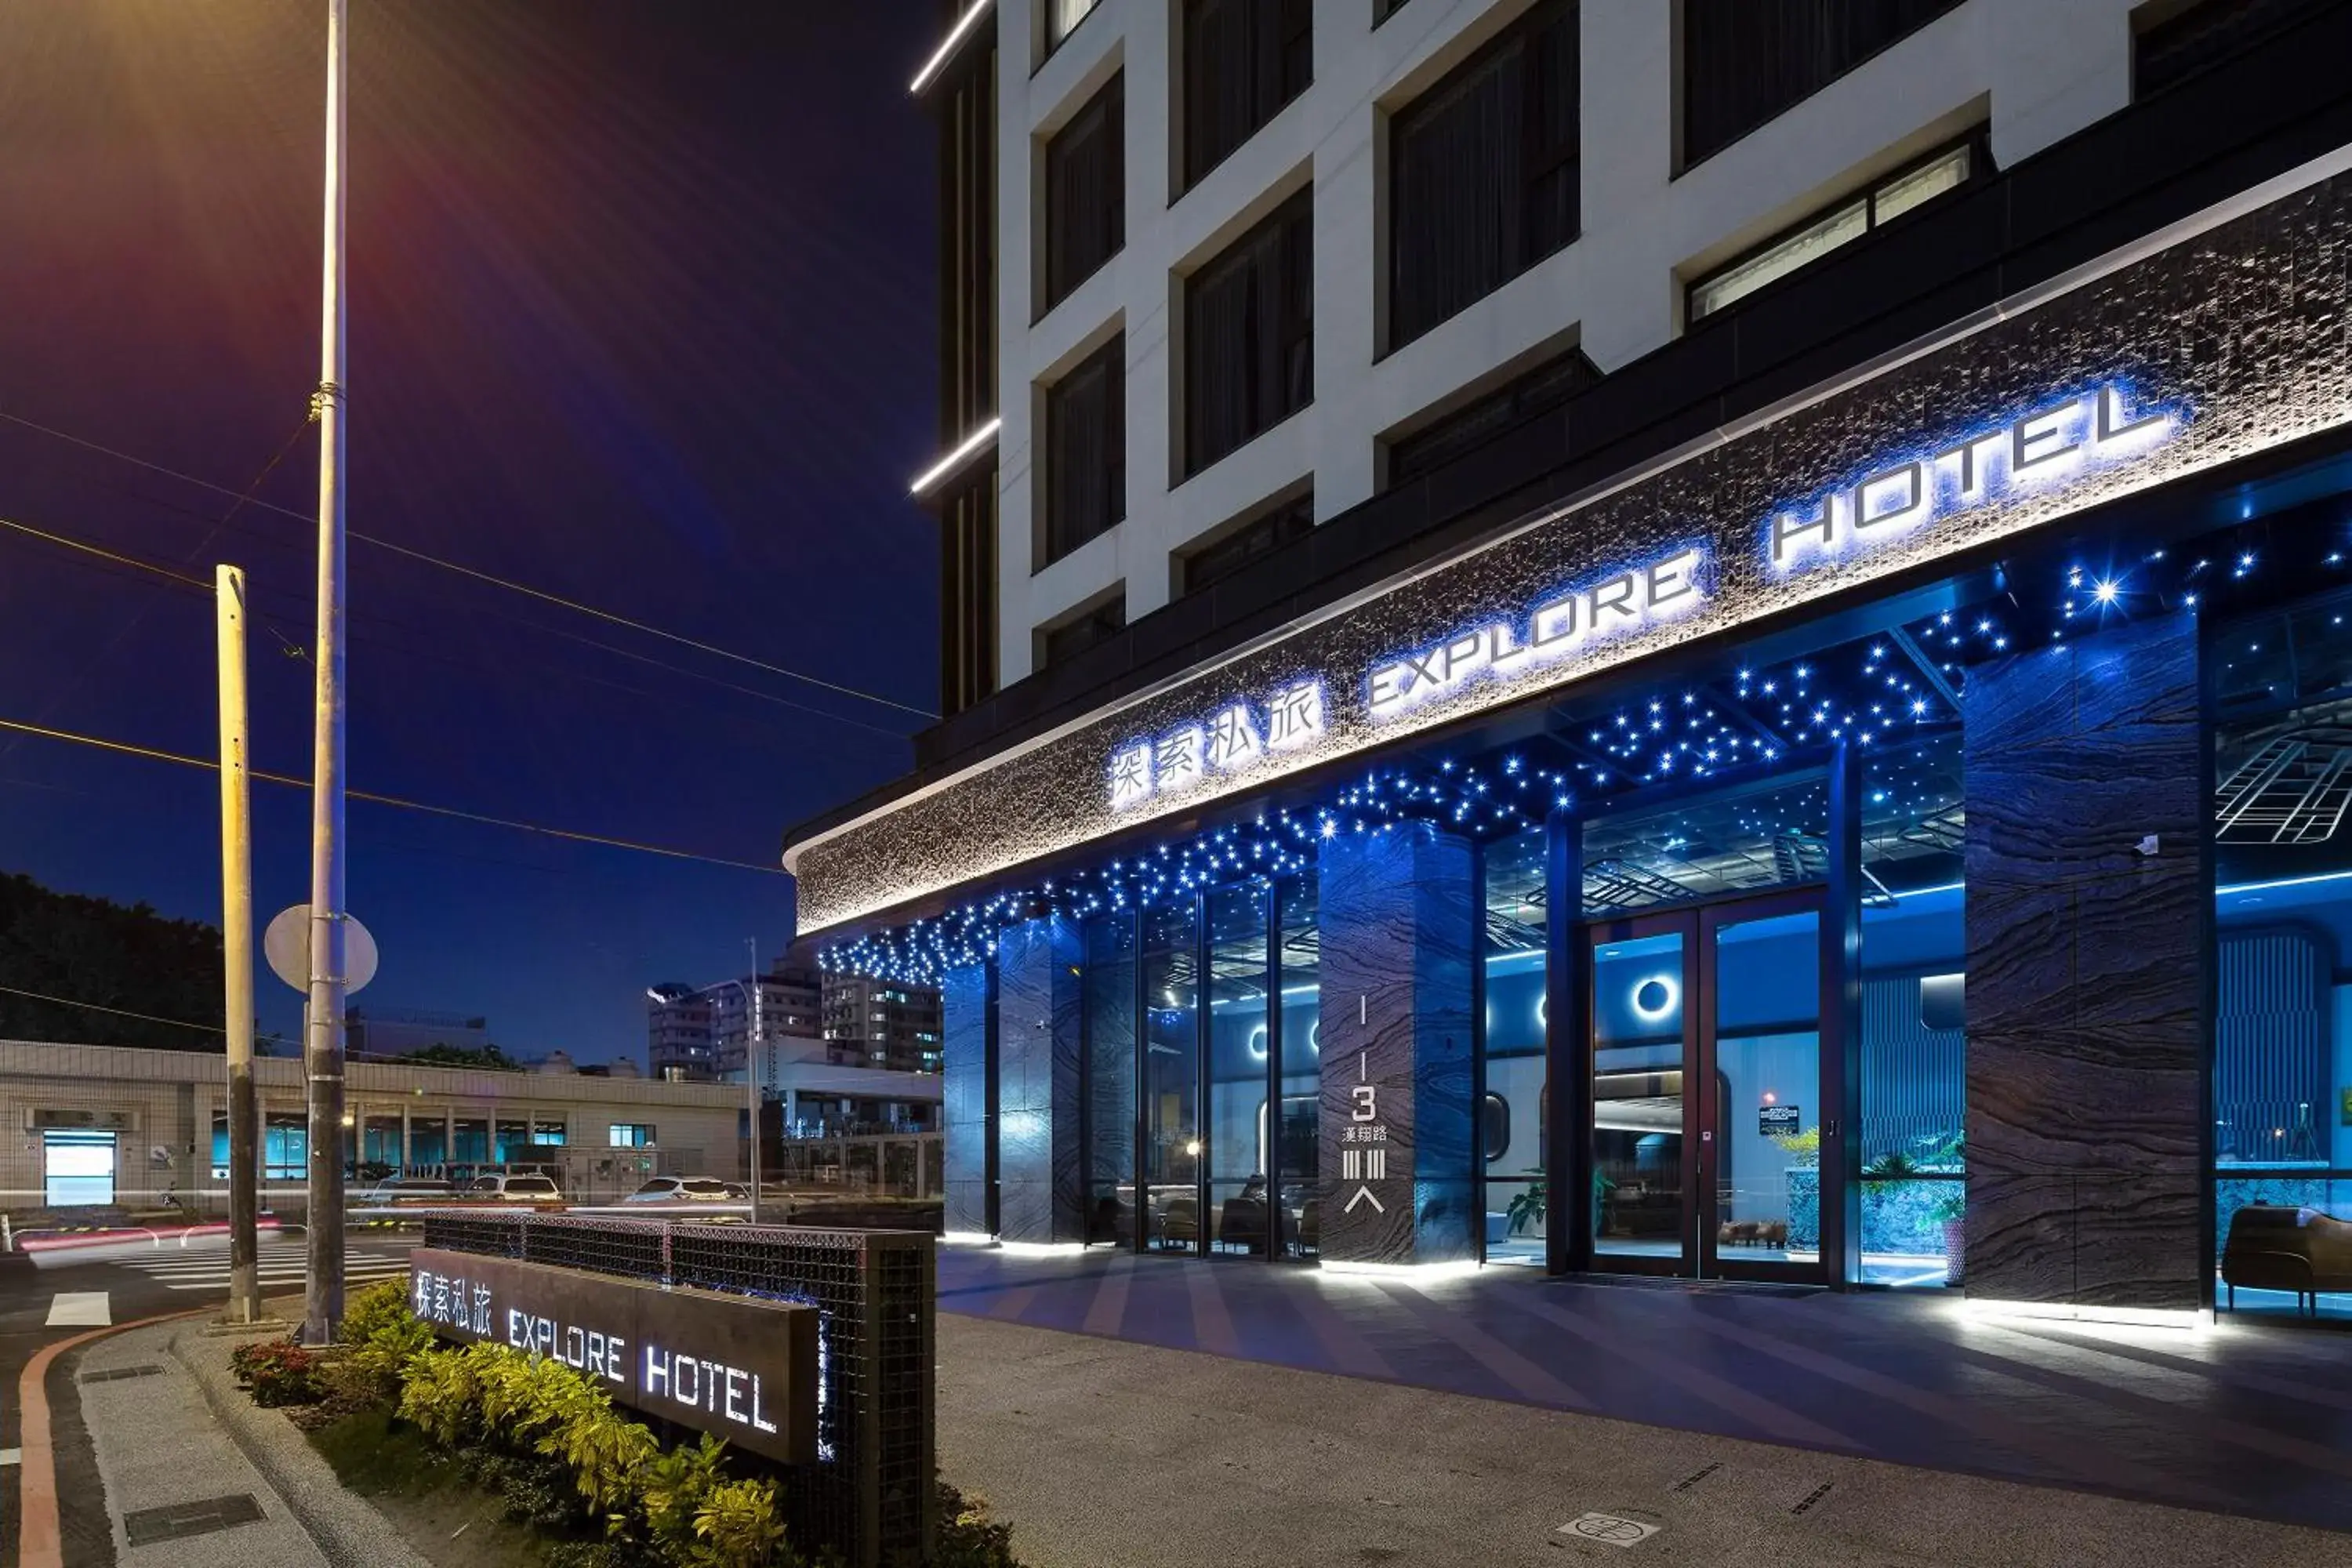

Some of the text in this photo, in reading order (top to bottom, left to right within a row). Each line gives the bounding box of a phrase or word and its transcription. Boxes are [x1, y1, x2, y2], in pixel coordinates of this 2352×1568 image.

[1108, 386, 2165, 798] 探索私旅 EXPLORE HOTEL
[416, 1270, 777, 1434] 探索私旅 EXPLORE HOTEL
